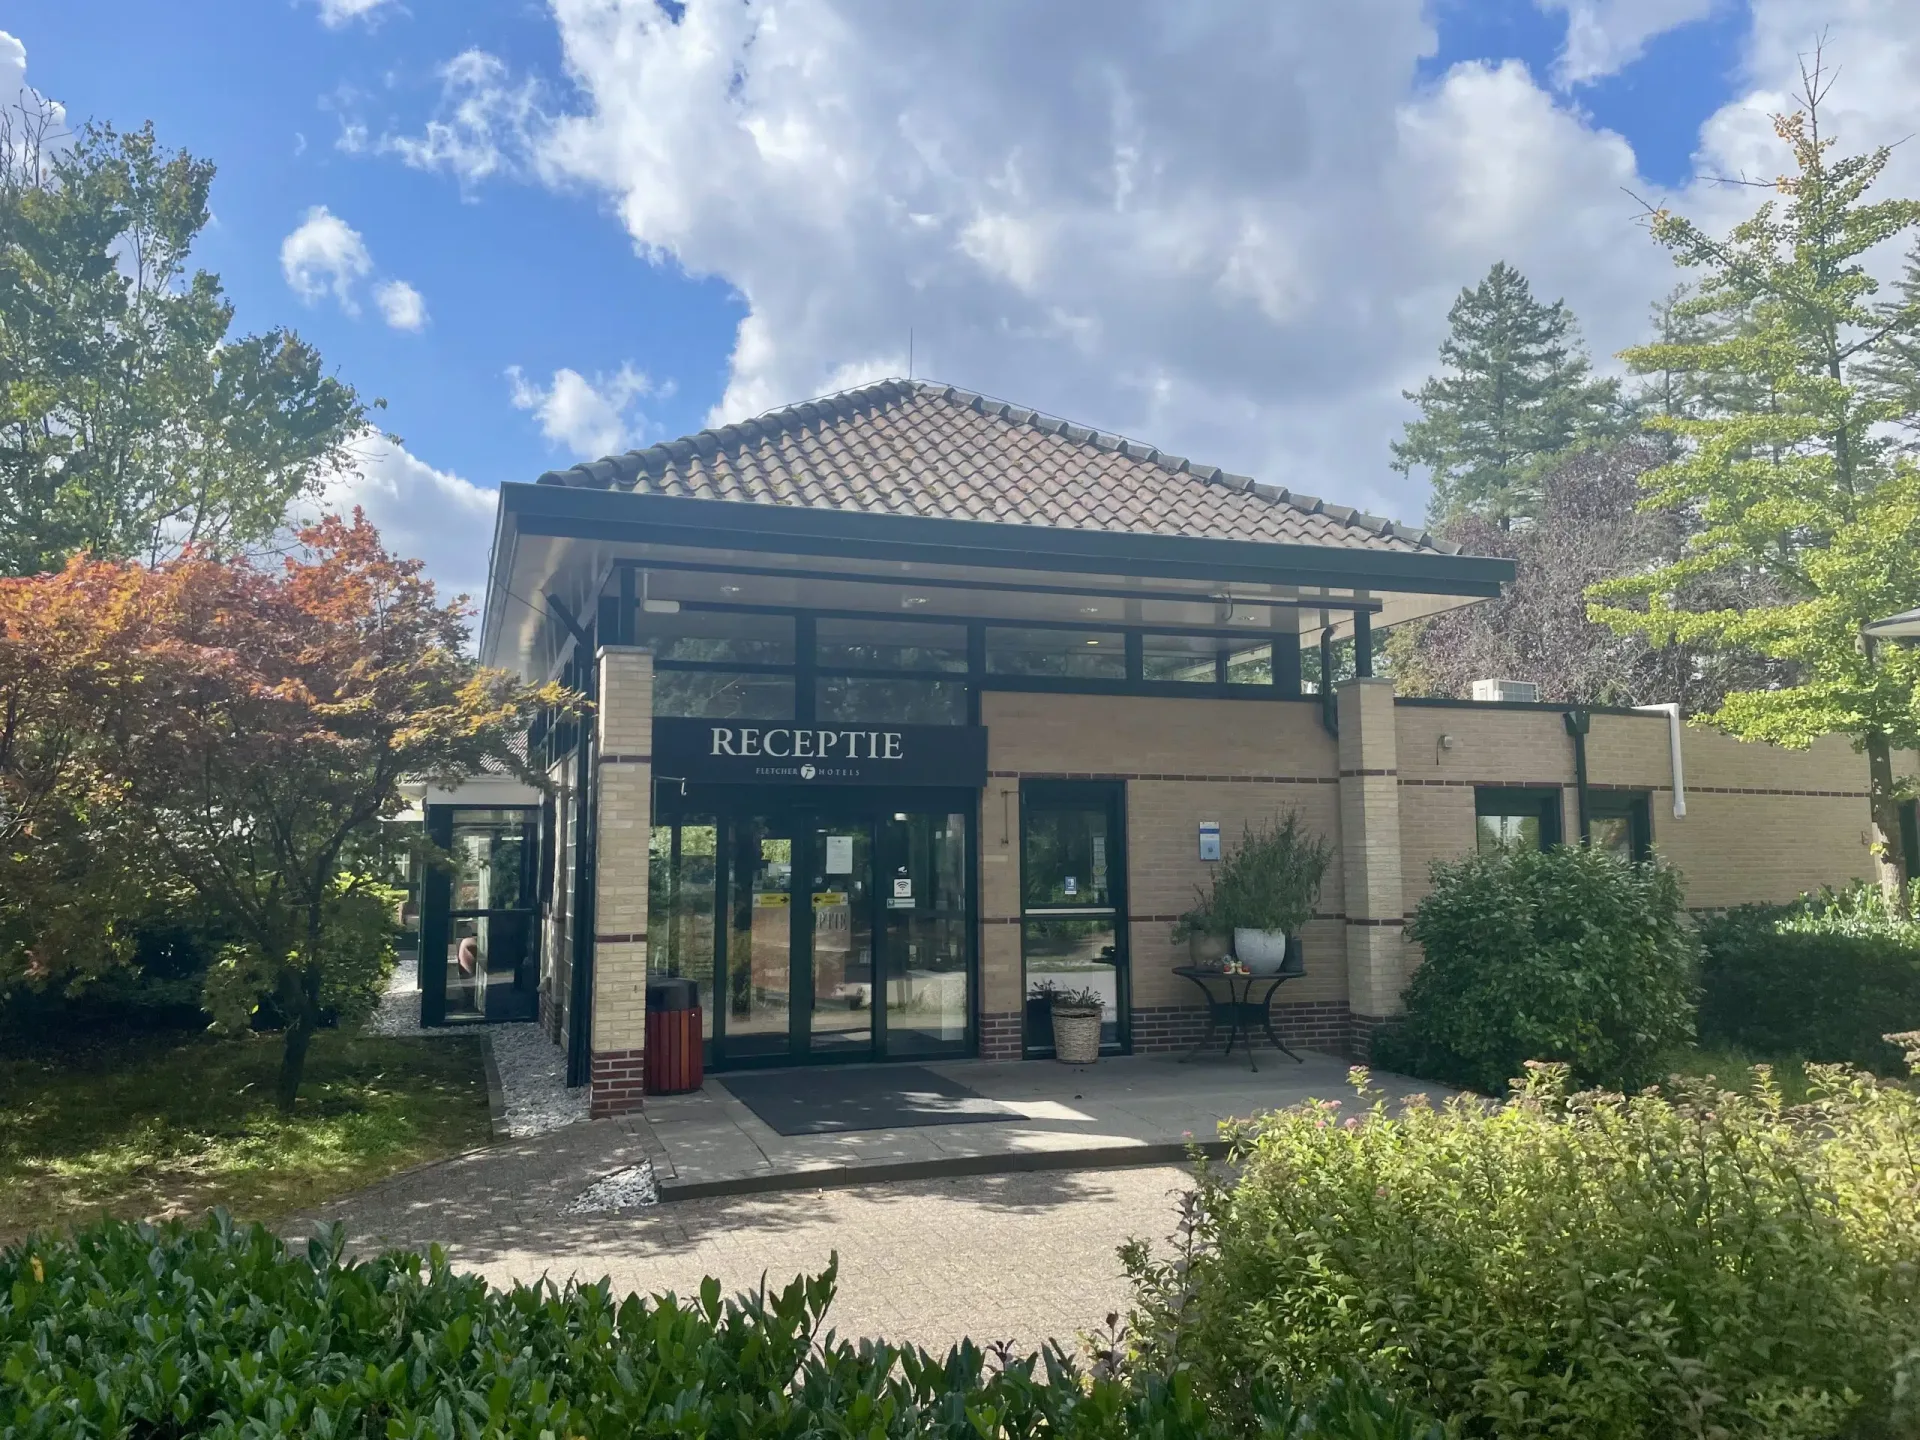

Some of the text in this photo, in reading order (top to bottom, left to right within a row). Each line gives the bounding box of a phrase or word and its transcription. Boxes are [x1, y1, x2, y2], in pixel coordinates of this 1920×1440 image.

[709, 727, 904, 760] RECEPTIE
[755, 767, 860, 776] FLETCHER HOTELS
